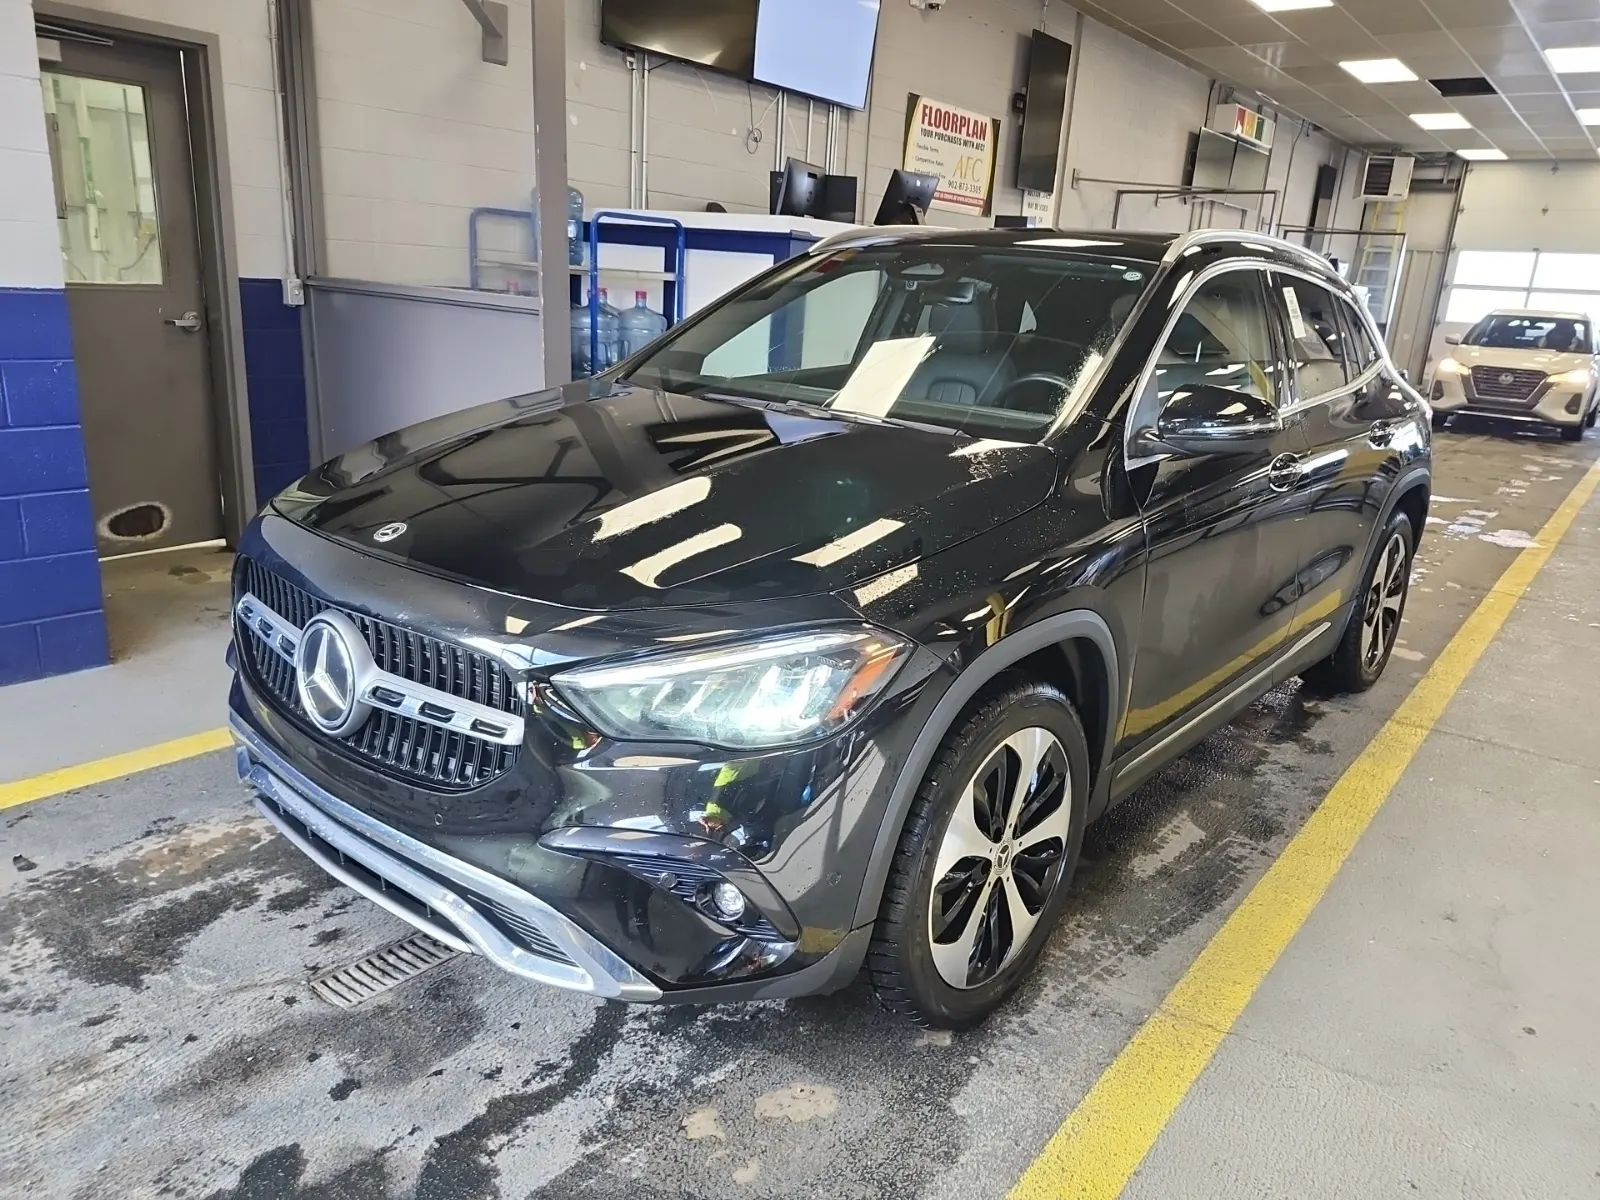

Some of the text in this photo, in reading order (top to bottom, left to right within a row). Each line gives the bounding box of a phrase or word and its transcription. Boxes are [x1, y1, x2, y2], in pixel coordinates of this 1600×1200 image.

[921, 103, 987, 141] FLOORPLAN
[920, 128, 934, 138] YOUR
[934, 131, 962, 146] PURCHASES
[963, 139, 974, 148] WITH
[915, 155, 935, 165] Competitive
[952, 154, 983, 182] AFC
[947, 179, 982, 194] 902-873-3305
